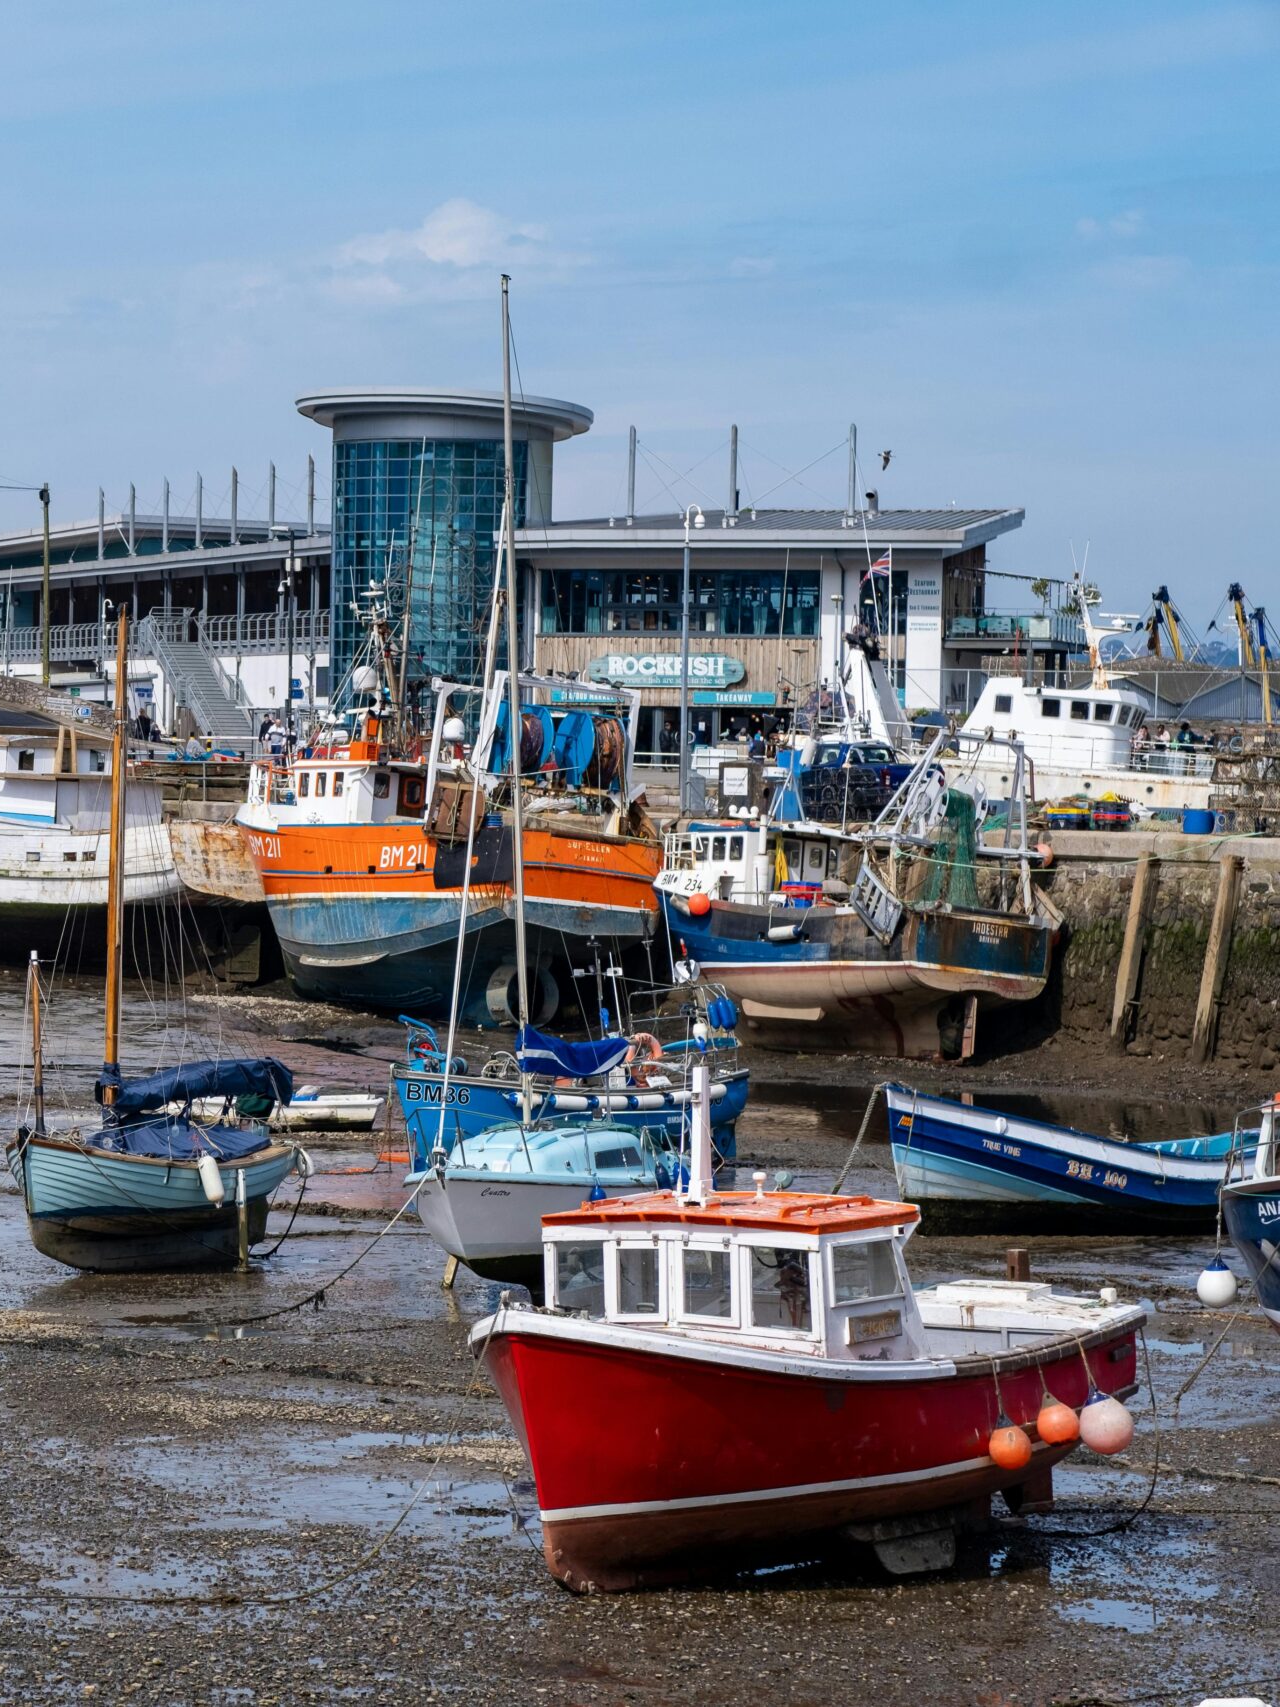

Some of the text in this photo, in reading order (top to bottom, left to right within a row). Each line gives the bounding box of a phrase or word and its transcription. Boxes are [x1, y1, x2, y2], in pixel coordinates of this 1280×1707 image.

[608, 656, 726, 676] ROCKFISH
[716, 693, 753, 703] TAKEAWAY
[248, 834, 281, 858] BM 211
[380, 843, 428, 868] BM 211
[684, 878, 703, 892] 234
[972, 922, 1009, 939] JADESTAR
[406, 1082, 470, 1105] BM36
[982, 1139, 1022, 1157] TRUE VINE
